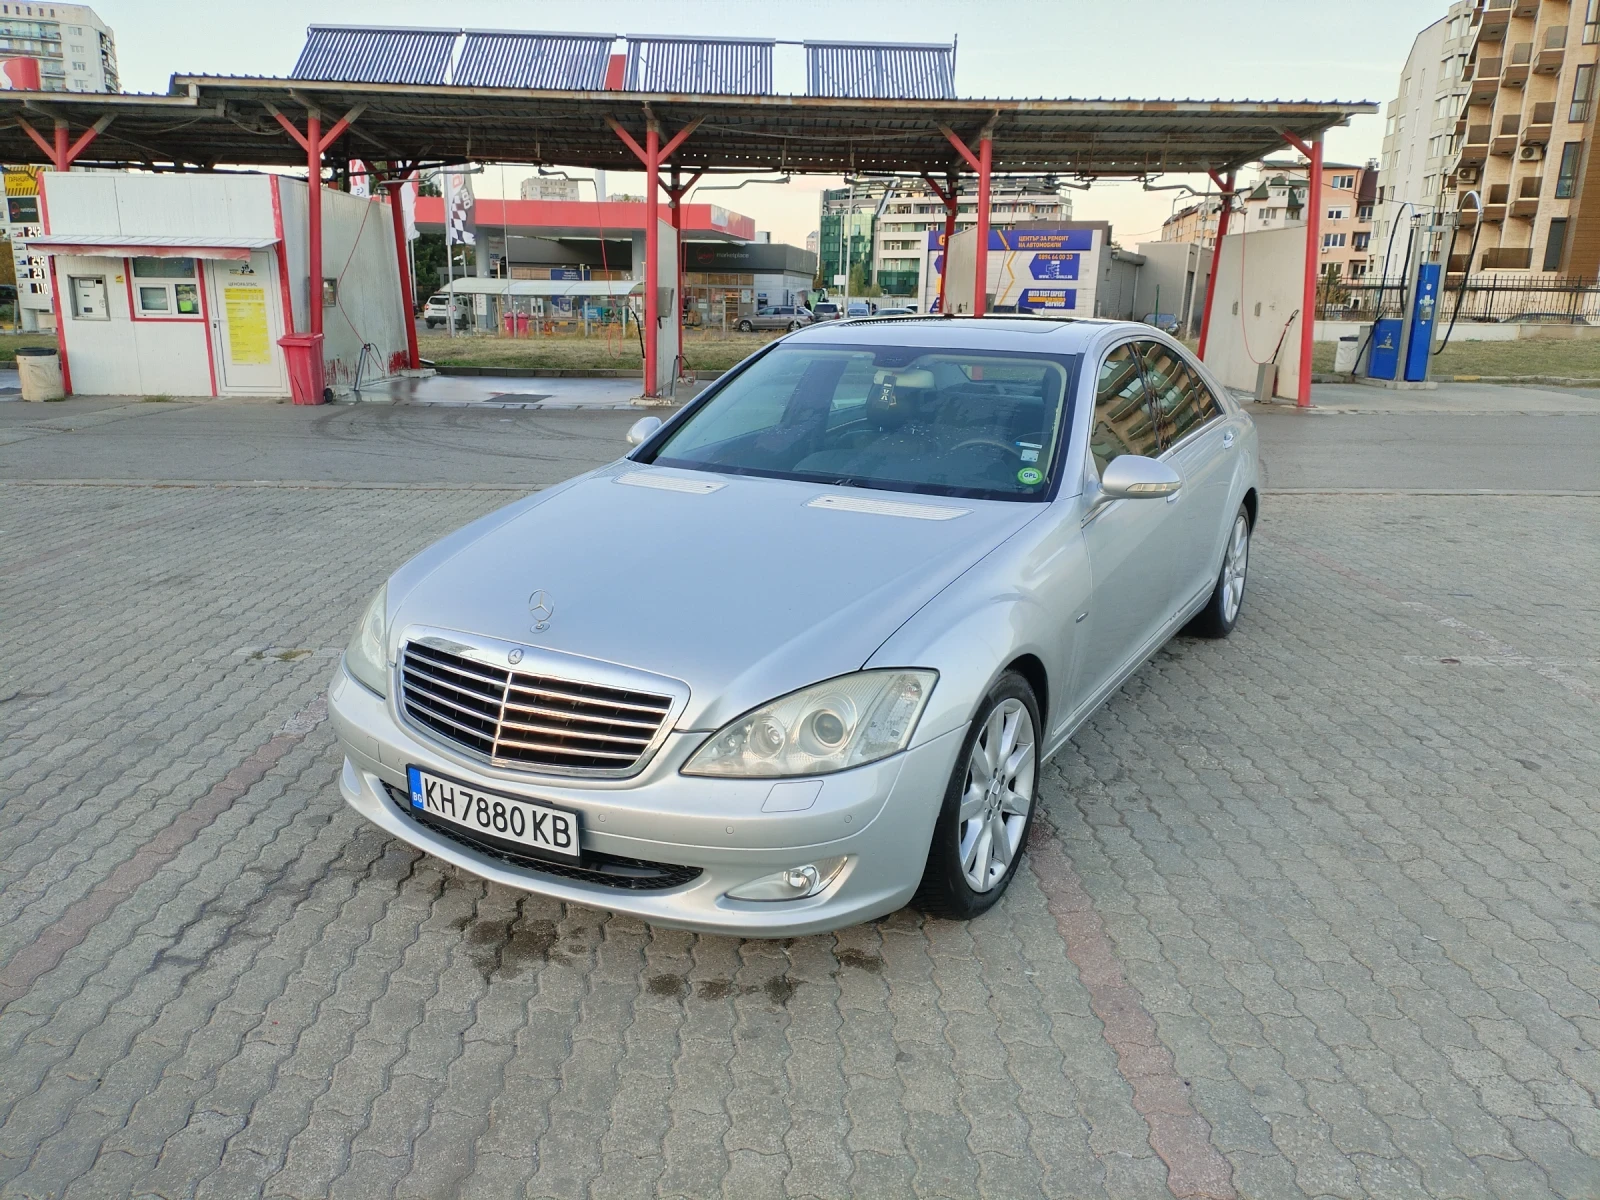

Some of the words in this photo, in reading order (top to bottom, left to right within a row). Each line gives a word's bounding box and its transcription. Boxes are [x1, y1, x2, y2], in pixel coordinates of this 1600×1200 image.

[28, 226, 42, 238] 242
[33, 267, 47, 279] 291
[413, 792, 423, 803] BG
